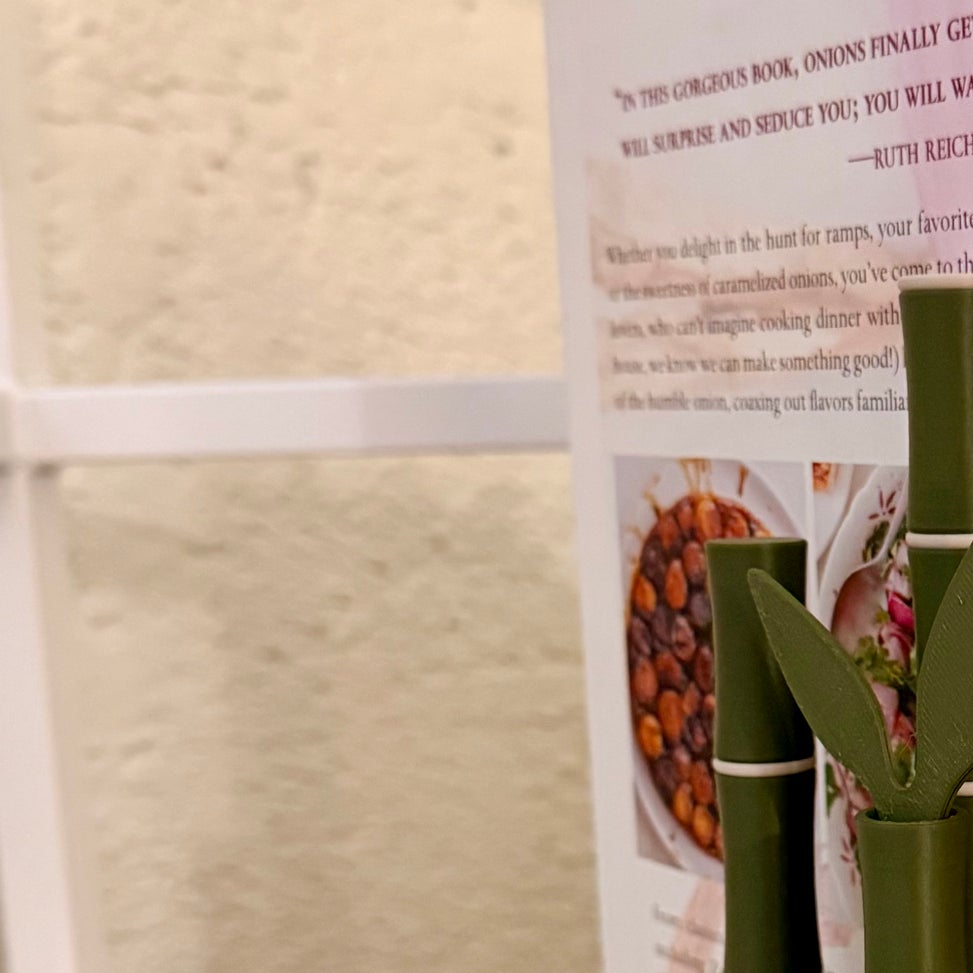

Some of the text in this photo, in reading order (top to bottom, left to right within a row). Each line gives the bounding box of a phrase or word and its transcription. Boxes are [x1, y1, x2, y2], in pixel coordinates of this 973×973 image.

[640, 85, 670, 109] THIS
[673, 66, 748, 101] GORGEOUS
[751, 57, 799, 85] BOOK,
[804, 40, 866, 73] ONIONS
[871, 23, 940, 58] FINALLY
[620, 137, 650, 159] WILL
[652, 127, 715, 155] SURPRISE
[720, 118, 751, 142] AND
[756, 107, 814, 135] SEDUCE
[819, 100, 859, 124] YOU;
[864, 89, 899, 115] YOU
[904, 81, 946, 108] WILL
[680, 238, 721, 264] delight
[725, 238, 737, 254] in
[741, 232, 761, 252] the
[766, 229, 797, 251] hunt
[802, 224, 820, 247] for
[826, 224, 873, 249] ramps,
[878, 220, 912, 246] your
[712, 269, 785, 295] caramelized
[789, 271, 838, 291] onions,
[841, 262, 888, 293] you’ve
[937, 260, 953, 274] to
[707, 317, 755, 340] imagine
[760, 311, 810, 336] cooking
[816, 306, 861, 329] dinner
[868, 303, 899, 325] with
[743, 351, 776, 372] make
[779, 348, 850, 377] something
[853, 346, 900, 377] good!)
[733, 392, 782, 416] coaxing
[784, 393, 806, 411] out
[810, 389, 854, 412] flavors
[857, 387, 908, 412] familia
